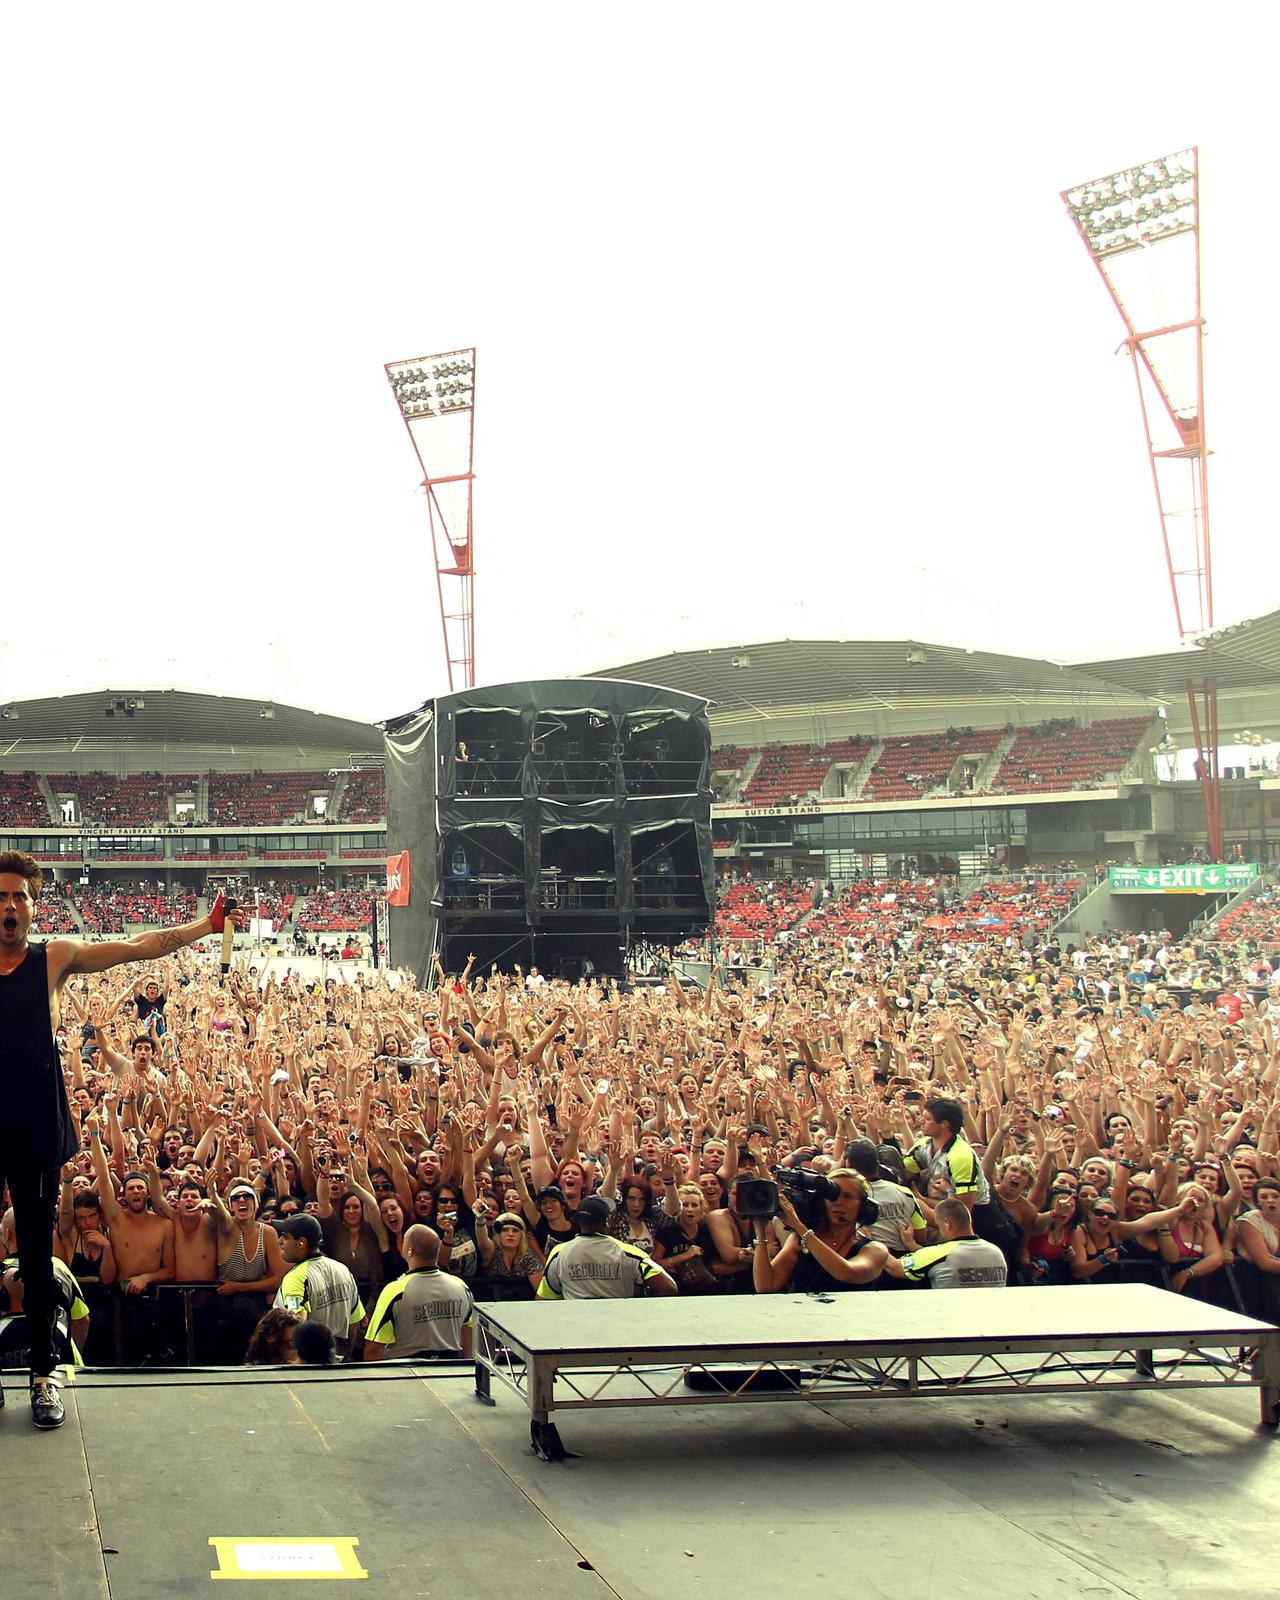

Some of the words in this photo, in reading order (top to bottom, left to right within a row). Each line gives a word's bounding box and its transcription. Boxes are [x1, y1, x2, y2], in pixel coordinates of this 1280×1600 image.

[745, 808, 781, 816] SUTTOR
[788, 806, 821, 814] STAND
[1159, 868, 1205, 886] EXIT
[568, 1262, 621, 1279] SECURITY
[413, 1298, 463, 1321] SECURITY
